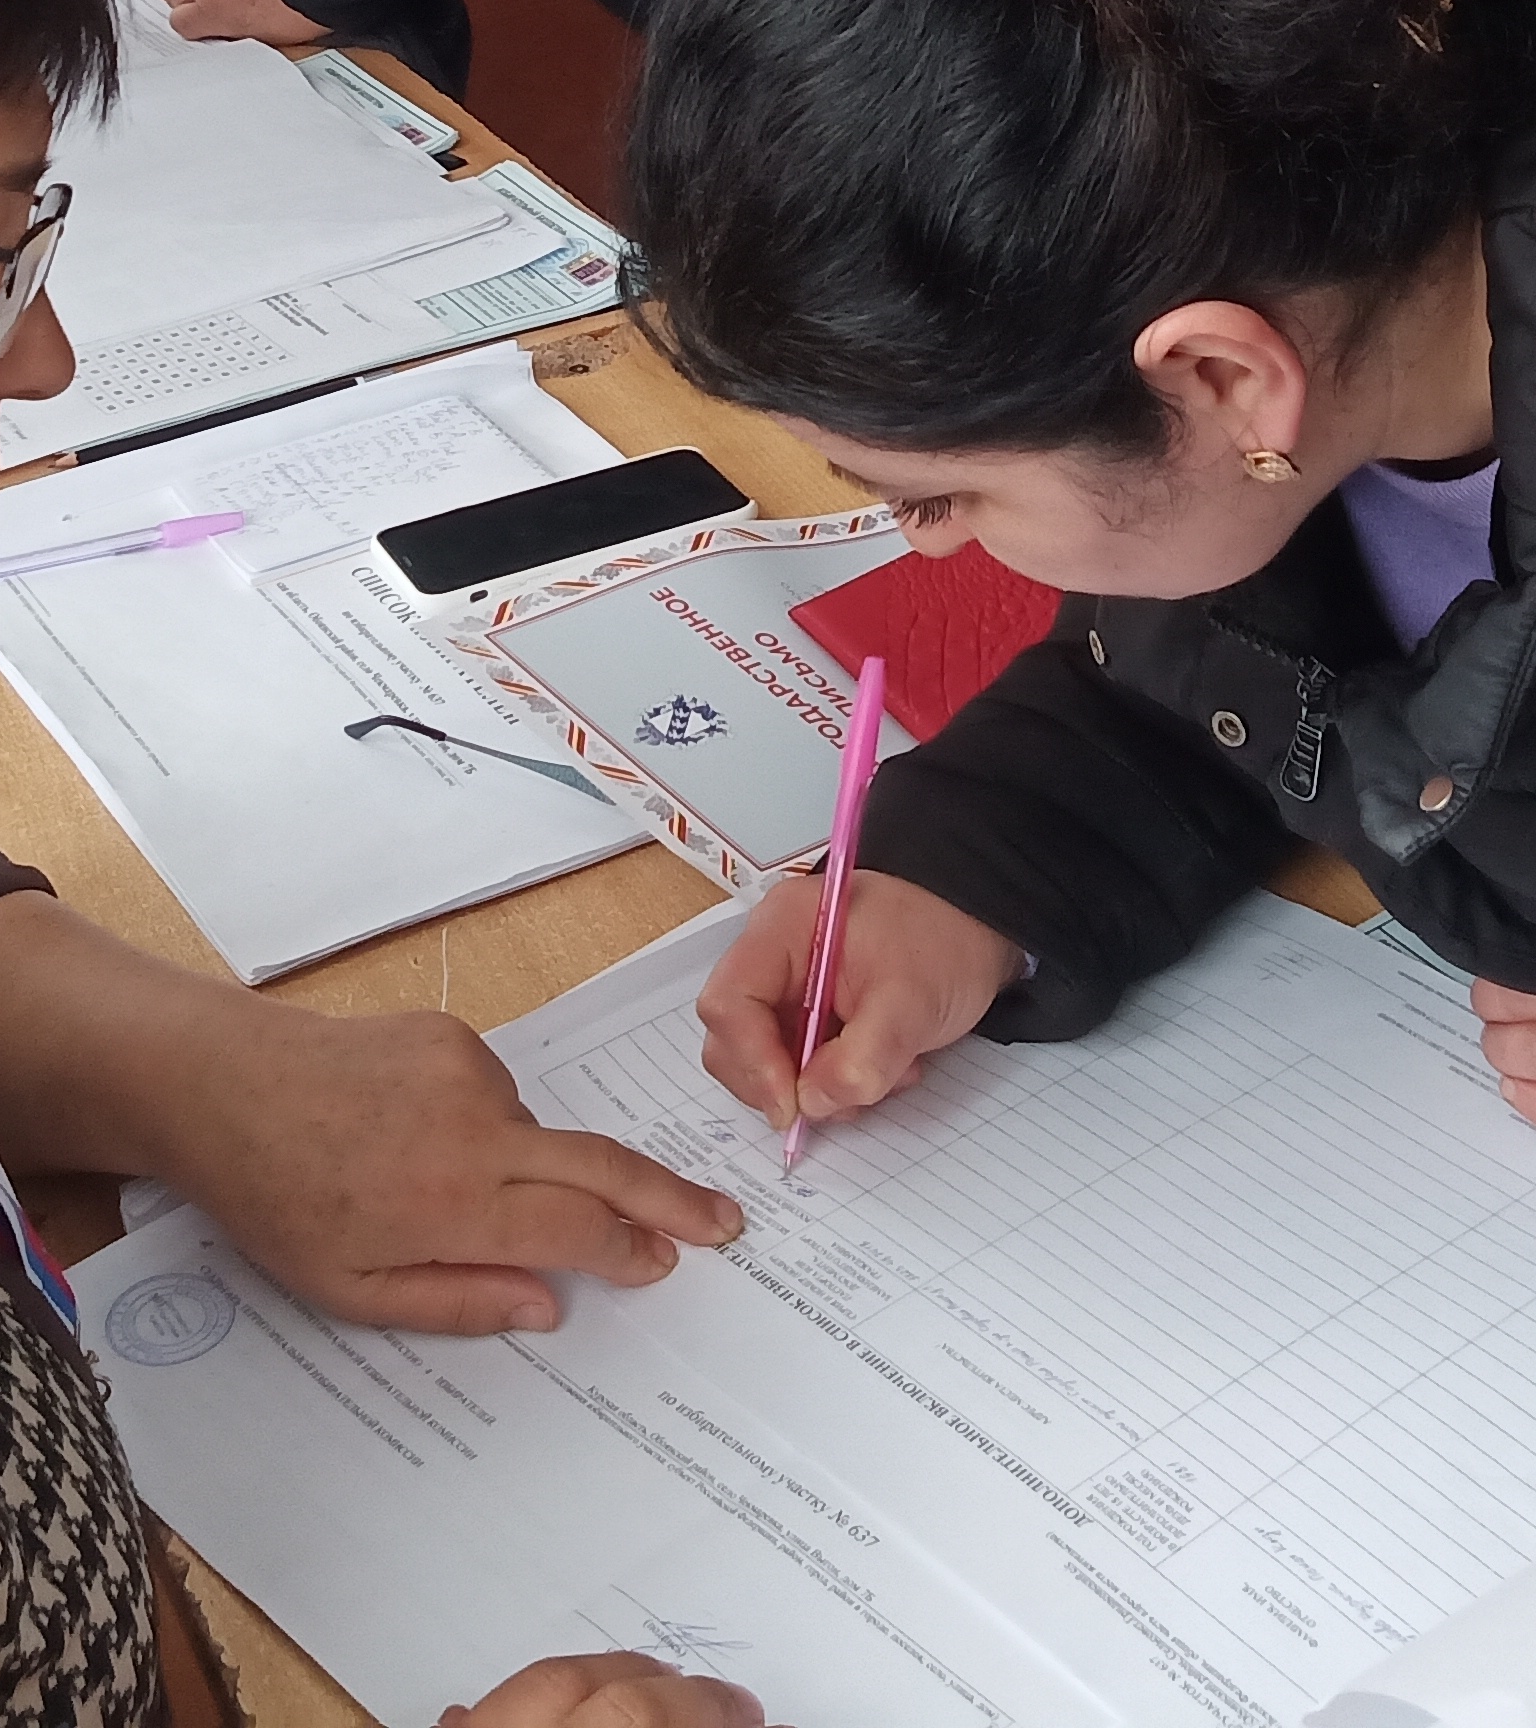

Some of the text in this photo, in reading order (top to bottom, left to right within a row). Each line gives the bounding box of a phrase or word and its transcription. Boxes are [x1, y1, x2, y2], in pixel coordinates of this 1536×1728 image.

[349, 563, 423, 626] СПИСОК
[649, 586, 846, 750] ГОДАРСТВЕННОЕ
[754, 632, 855, 718] ПИСЬМО
[424, 690, 446, 707] 637
[711, 1238, 795, 1302] ИЗБИРАТЕЛЕ
[787, 1295, 850, 1343] СПИСОК
[843, 1337, 861, 1352] В
[855, 1346, 950, 1419] ВКЛЮЧЕНИЕ
[655, 1386, 881, 1552] по избирательному участку № 637
[940, 1412, 1095, 1530] ДОПОЛНИТЕЛЬНОЕ
[1092, 1482, 1114, 1499] ЛЕТ
[1082, 1493, 1159, 1552] ГОД РОЖДЕНИЯ
[1099, 1474, 1189, 1540] ДОПОЛНИТЕЛЬНО
[1118, 1505, 1171, 1544] ВОЗРАСТЕ
[1260, 1583, 1321, 1628] ОТЧЕСТВО
[1147, 1652, 1170, 1673] 637
[1177, 1678, 1232, 1727] УЧАСТОК
